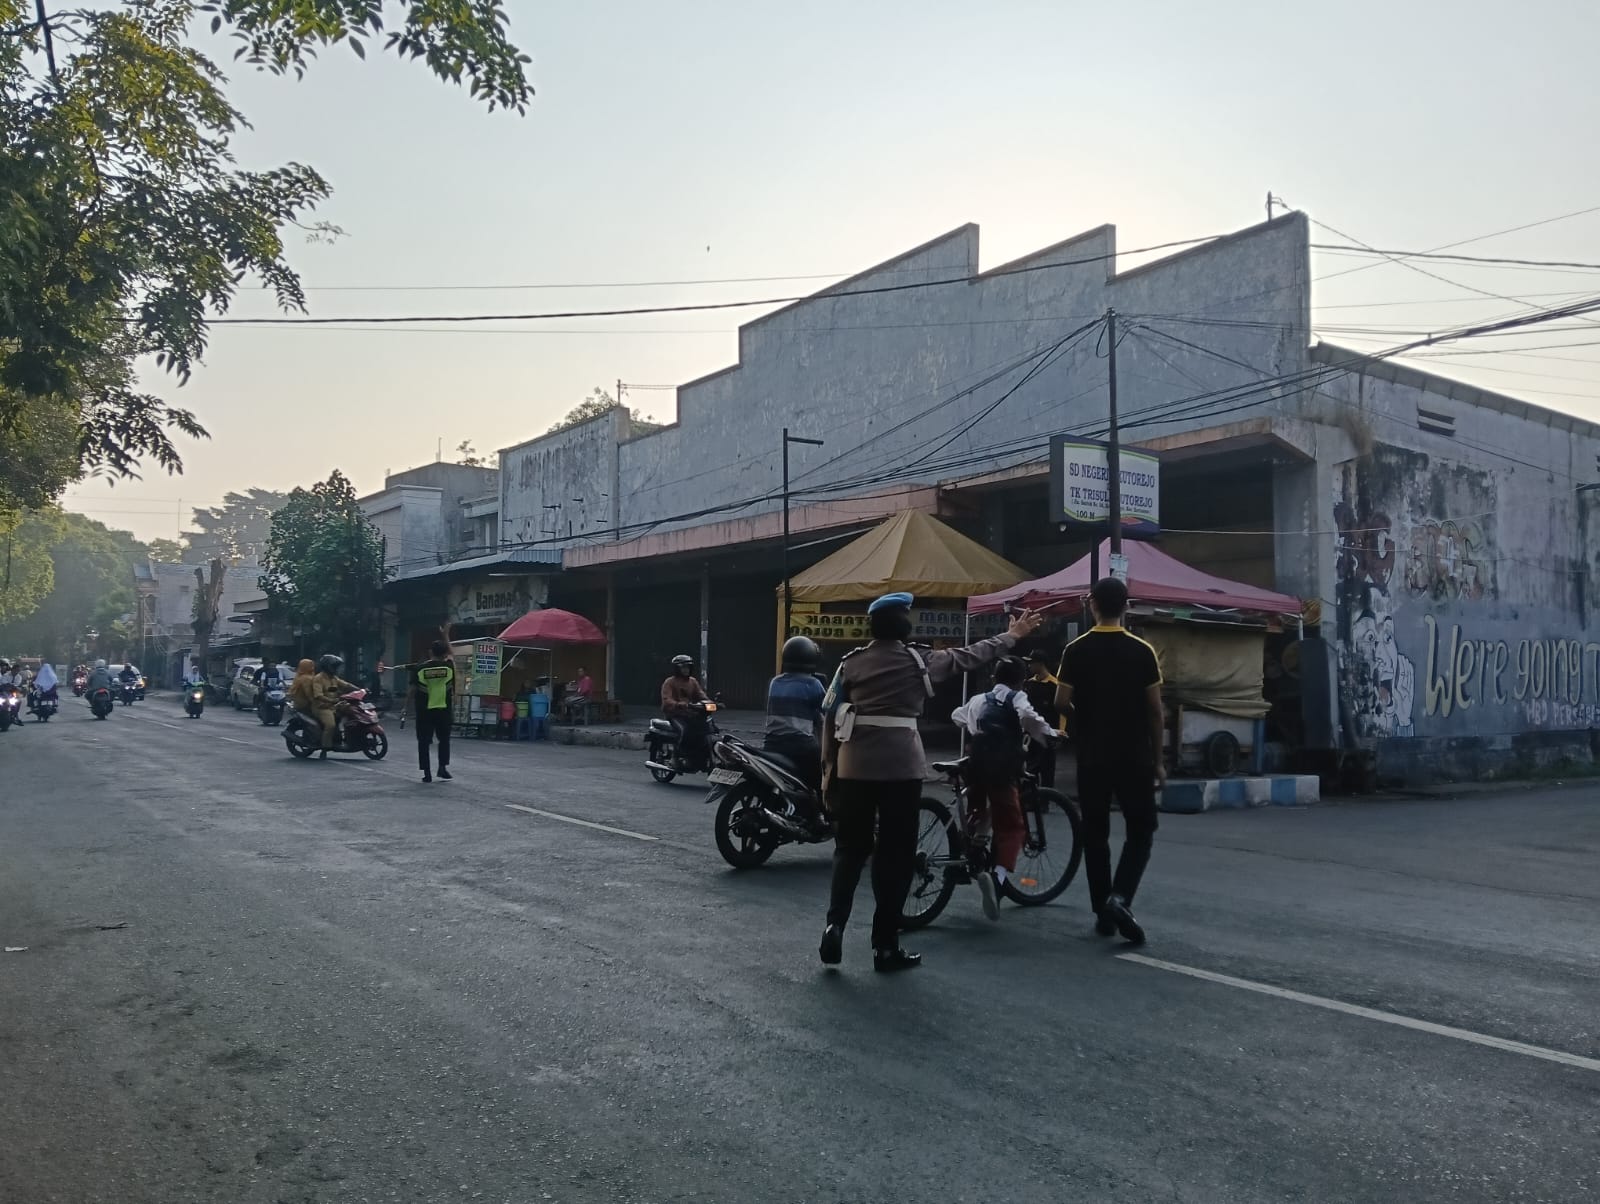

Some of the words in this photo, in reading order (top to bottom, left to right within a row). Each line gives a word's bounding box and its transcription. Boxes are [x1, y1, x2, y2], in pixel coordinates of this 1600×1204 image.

[1069, 462, 1079, 477] SD
[1119, 470, 1155, 488] UTOREJO
[1070, 486, 1081, 498] TK
[1082, 488, 1110, 502] TRISUL
[1120, 494, 1153, 508] UTOREJO
[1076, 510, 1088, 519] 100
[1423, 614, 1509, 718] We're
[1513, 639, 1583, 706] going
